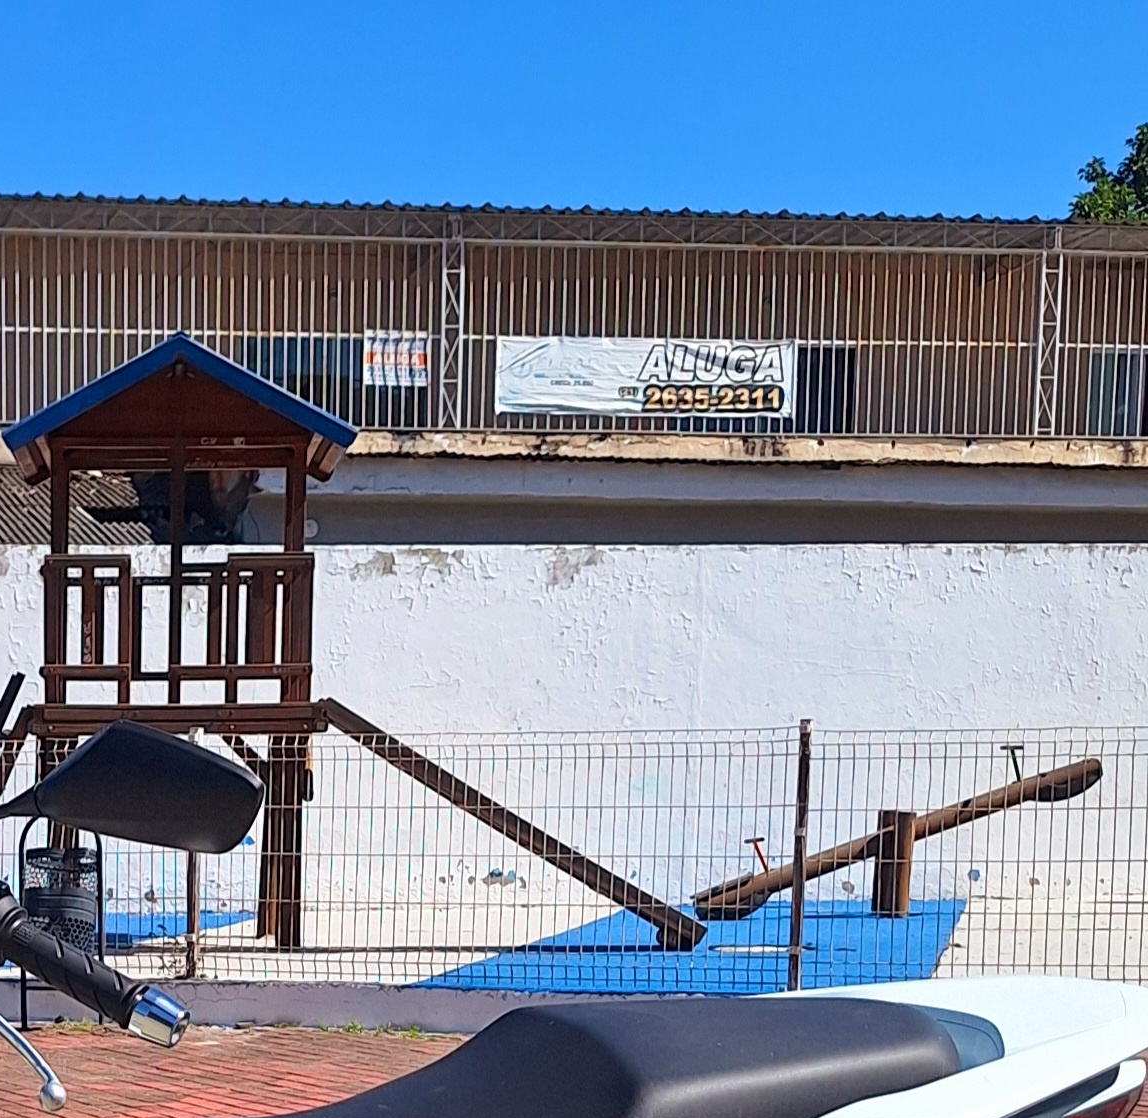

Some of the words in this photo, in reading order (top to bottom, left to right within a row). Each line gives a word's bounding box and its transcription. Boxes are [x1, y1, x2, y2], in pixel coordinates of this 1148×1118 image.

[636, 344, 784, 383] ALUGA
[618, 387, 639, 397] (21)
[643, 386, 782, 411] 2635-2311
